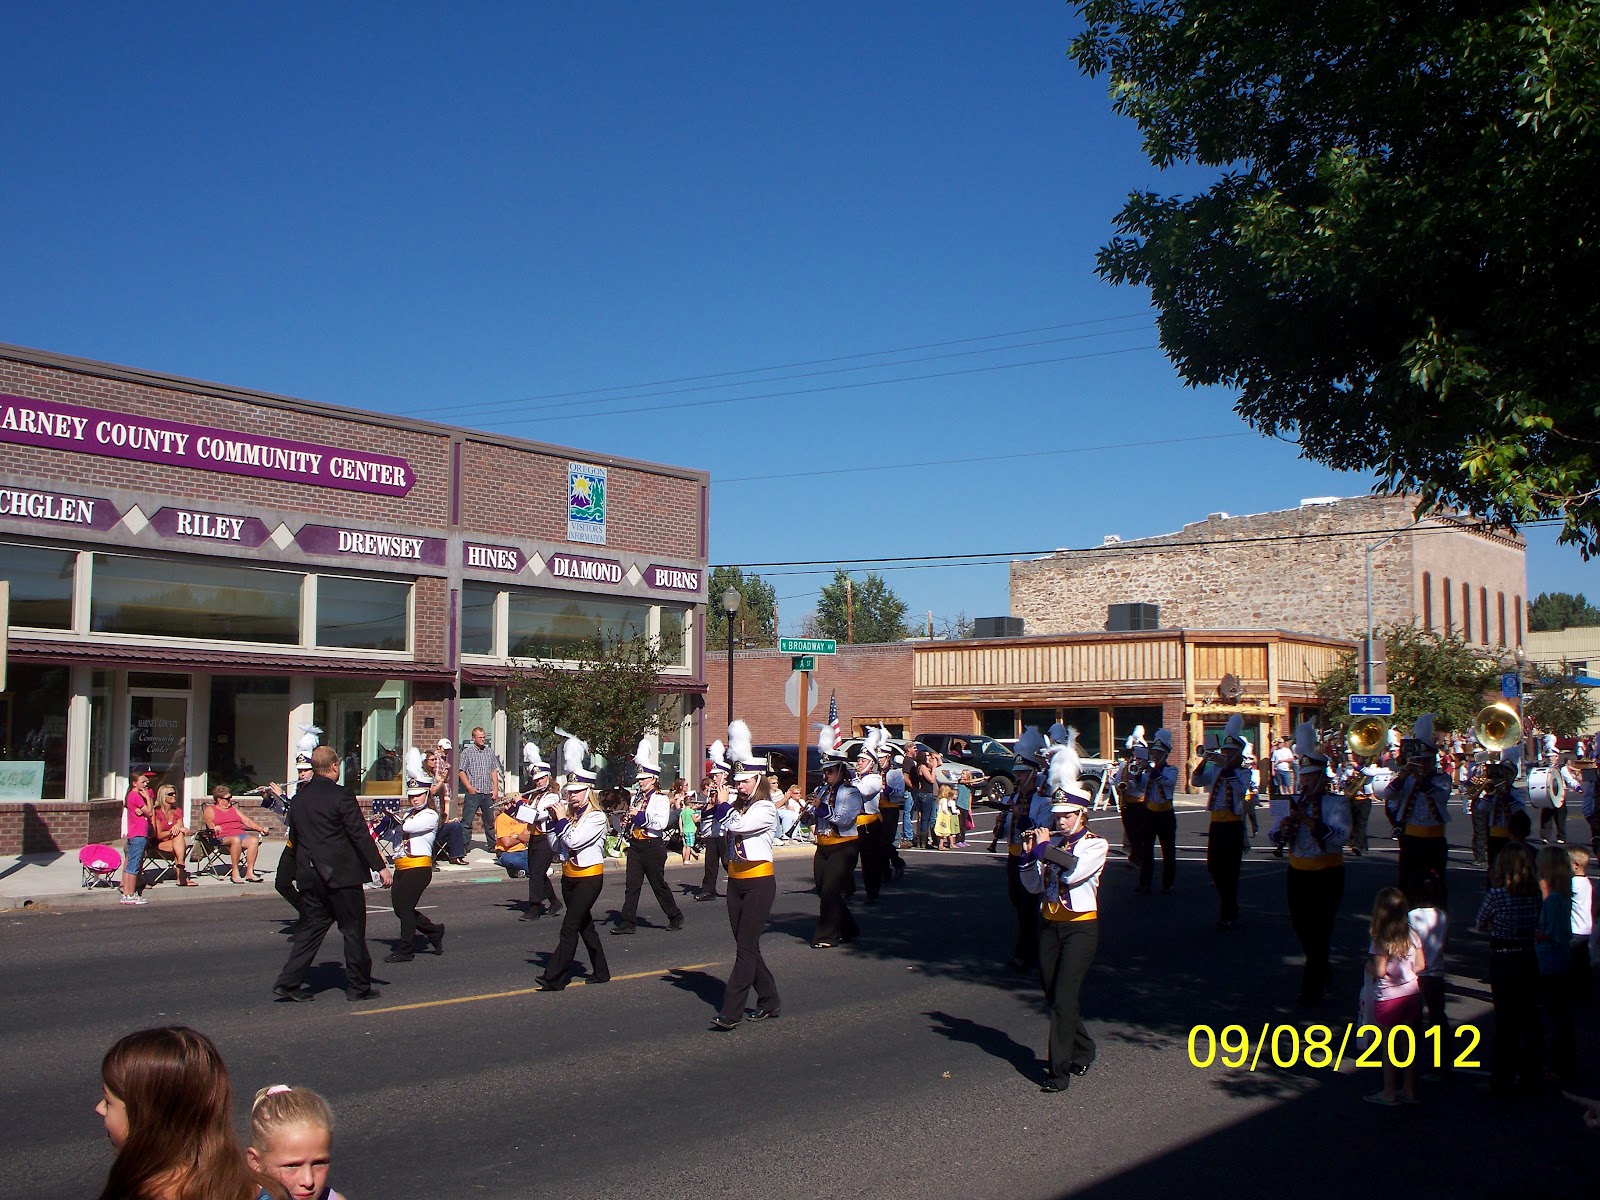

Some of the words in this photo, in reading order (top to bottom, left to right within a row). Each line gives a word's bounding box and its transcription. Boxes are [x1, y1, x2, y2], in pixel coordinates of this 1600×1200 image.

[0, 405, 88, 440] ARNEY
[96, 421, 189, 455] COUNTY
[197, 436, 322, 475] COMMUNITY
[329, 456, 407, 488] CENTER
[569, 462, 606, 476] OREGON
[176, 511, 245, 541] RILEY
[571, 522, 603, 534] VISITORS
[338, 530, 424, 559] DREWSEY
[568, 531, 605, 544] INFORMATION
[467, 546, 518, 570] HINES
[553, 557, 622, 583] DIAMOND
[654, 568, 698, 591] BURNS
[782, 642, 787, 650] N
[788, 641, 825, 651] BROADWAY
[800, 659, 805, 668] A
[138, 719, 157, 728] HARNEY
[159, 719, 178, 728] COUNTY
[139, 729, 174, 746] Community
[146, 742, 169, 753] Center
